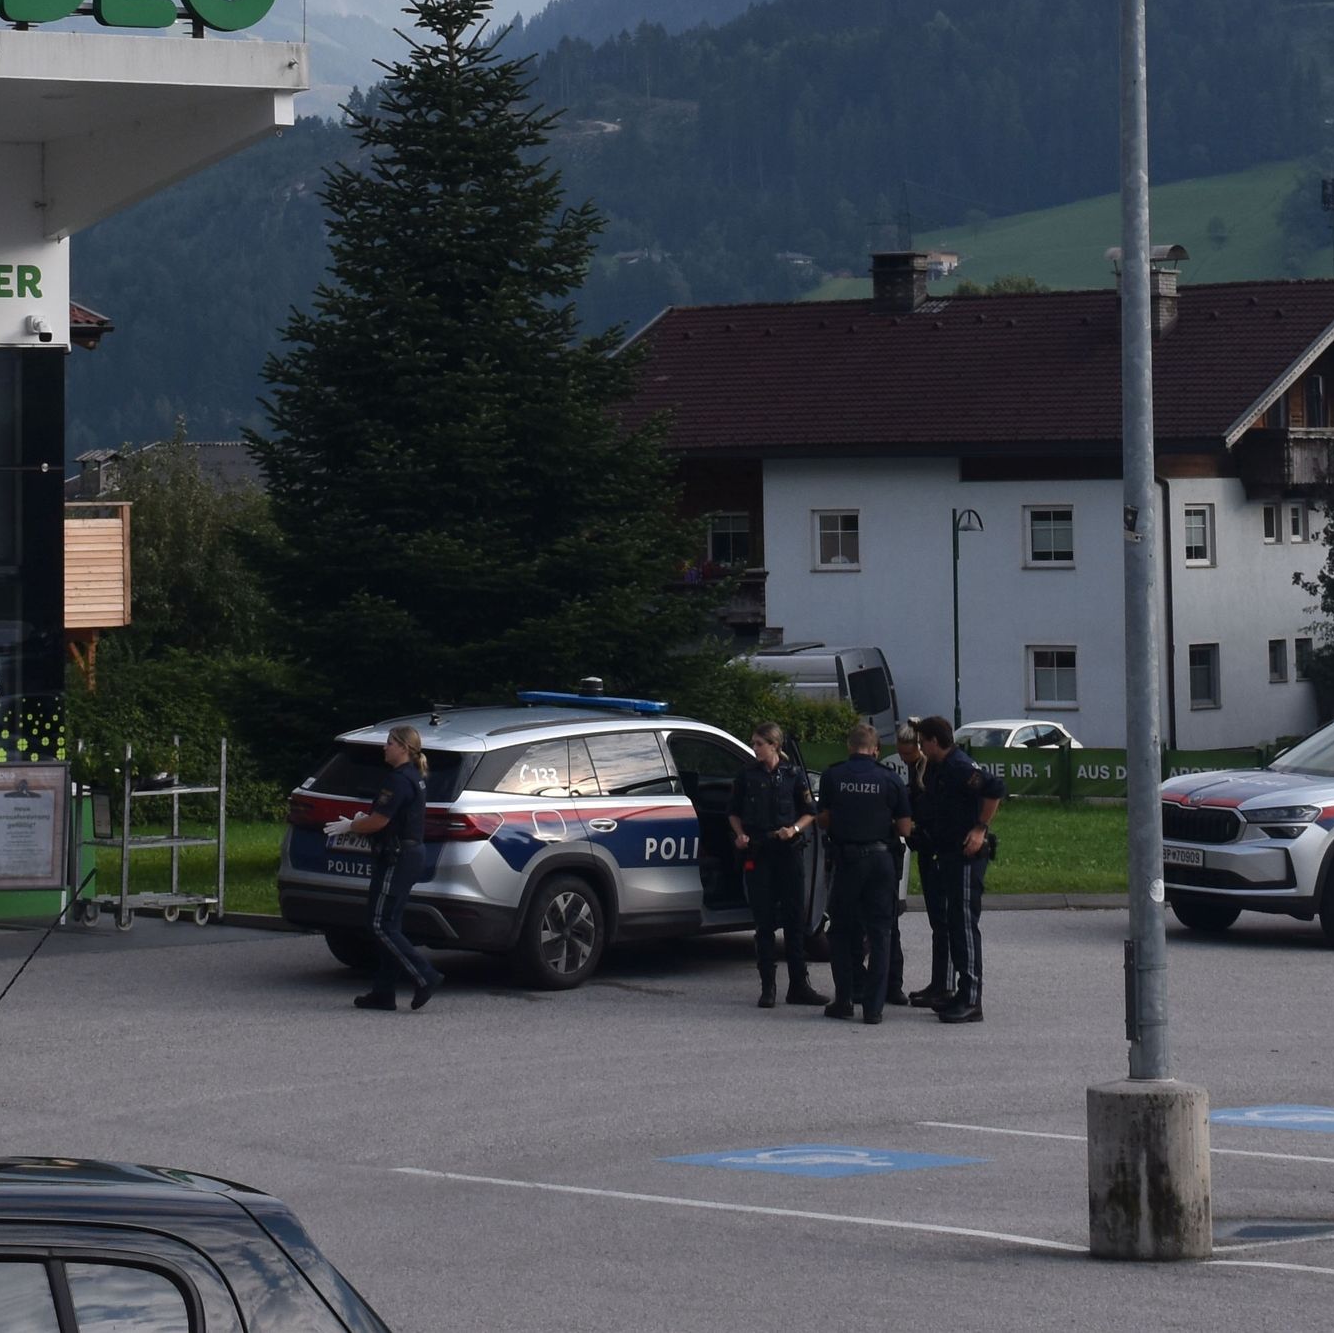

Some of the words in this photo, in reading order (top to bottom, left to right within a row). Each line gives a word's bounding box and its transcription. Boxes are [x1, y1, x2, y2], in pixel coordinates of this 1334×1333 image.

[530, 767, 559, 787] 133
[1011, 764, 1038, 779] NR.
[1042, 764, 1052, 779] 1
[1077, 764, 1110, 780] AUS
[840, 781, 880, 794] POLIZEI
[645, 836, 700, 861] POLI
[327, 859, 372, 876] POLIZE
